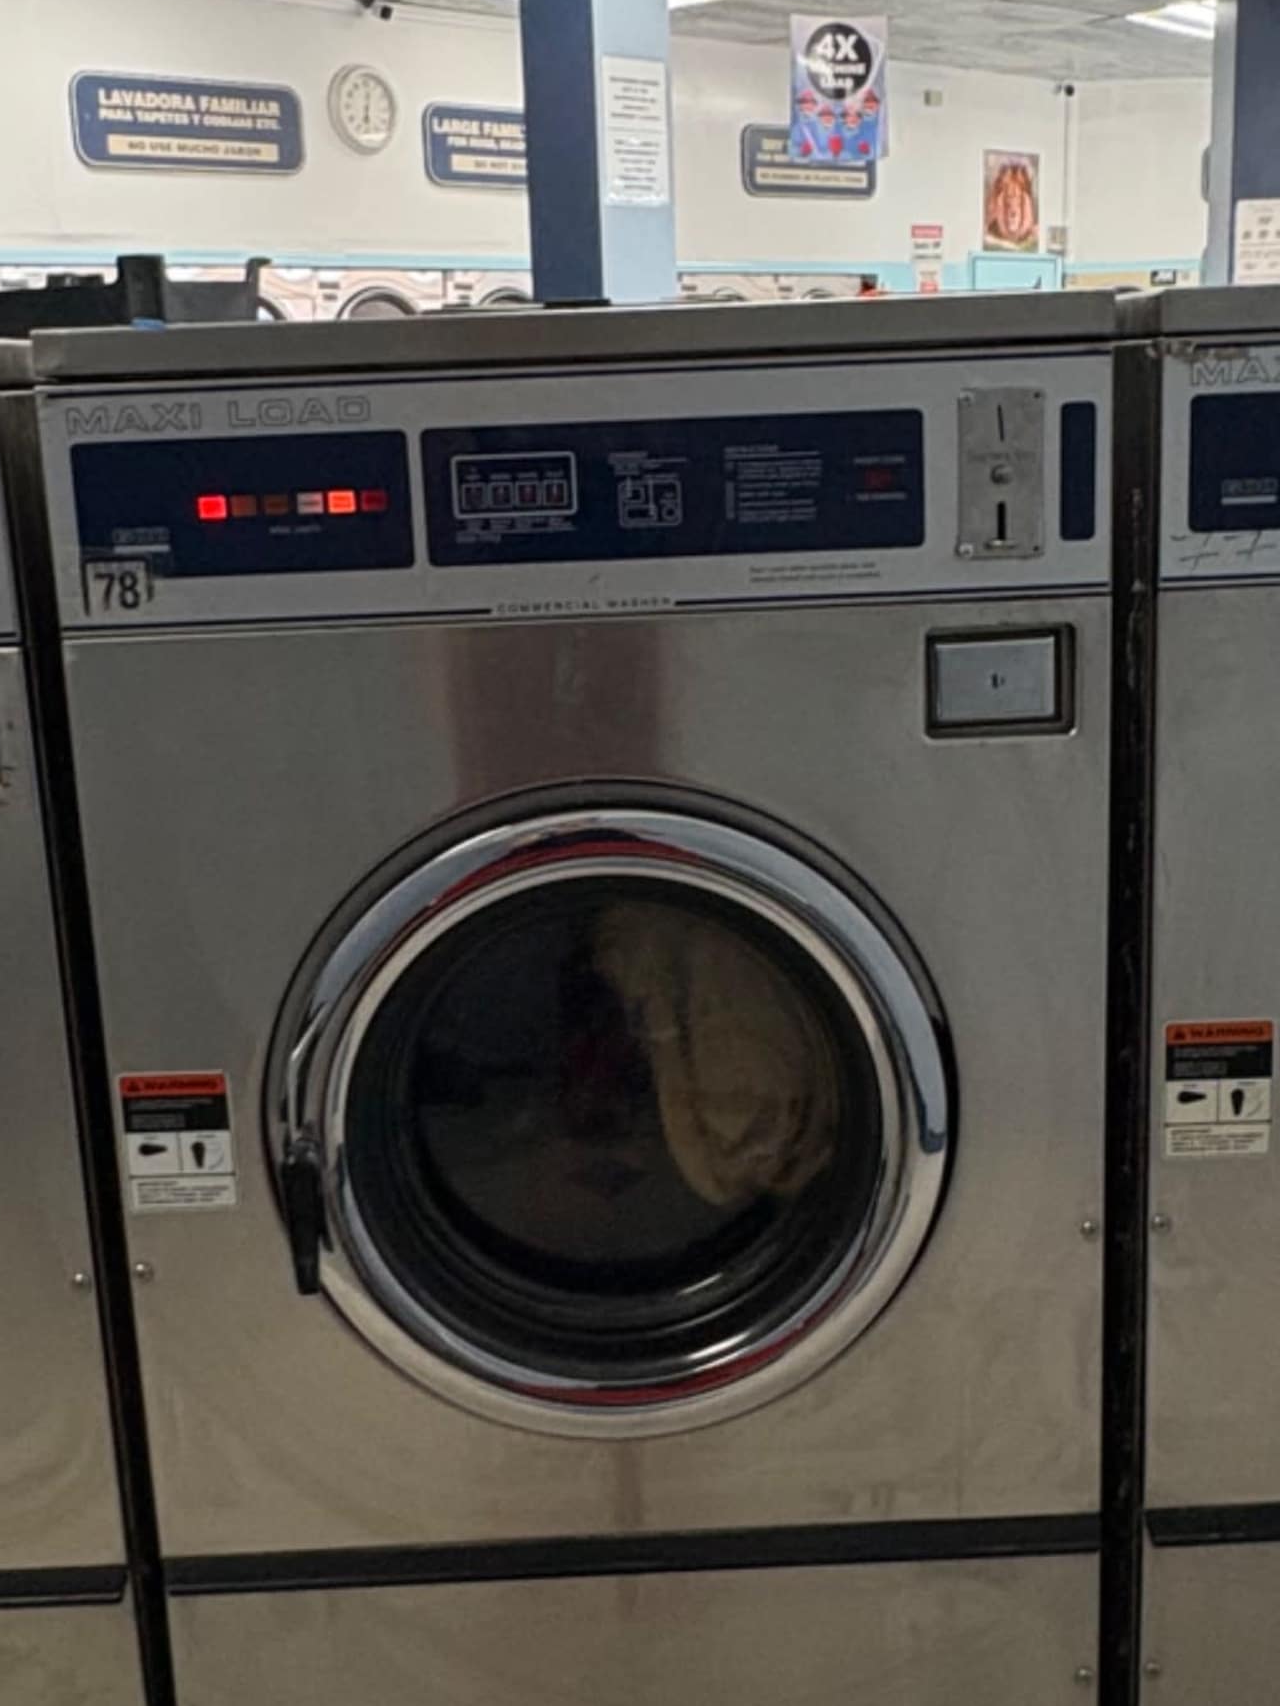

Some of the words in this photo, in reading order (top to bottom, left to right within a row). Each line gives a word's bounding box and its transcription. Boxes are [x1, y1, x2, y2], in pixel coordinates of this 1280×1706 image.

[816, 34, 858, 61] 4X
[808, 62, 866, 75] CHINE
[98, 88, 195, 111] LAVADORA
[199, 95, 280, 116] FAMILIAR
[127, 141, 146, 150] NO
[149, 142, 172, 151] USE
[176, 143, 219, 155] MUCHO
[65, 402, 202, 436] MAXI
[228, 395, 371, 428] LOAD
[93, 571, 140, 610] 78
[497, 601, 599, 612] COMMERCIAL
[607, 597, 670, 607] WASHER
